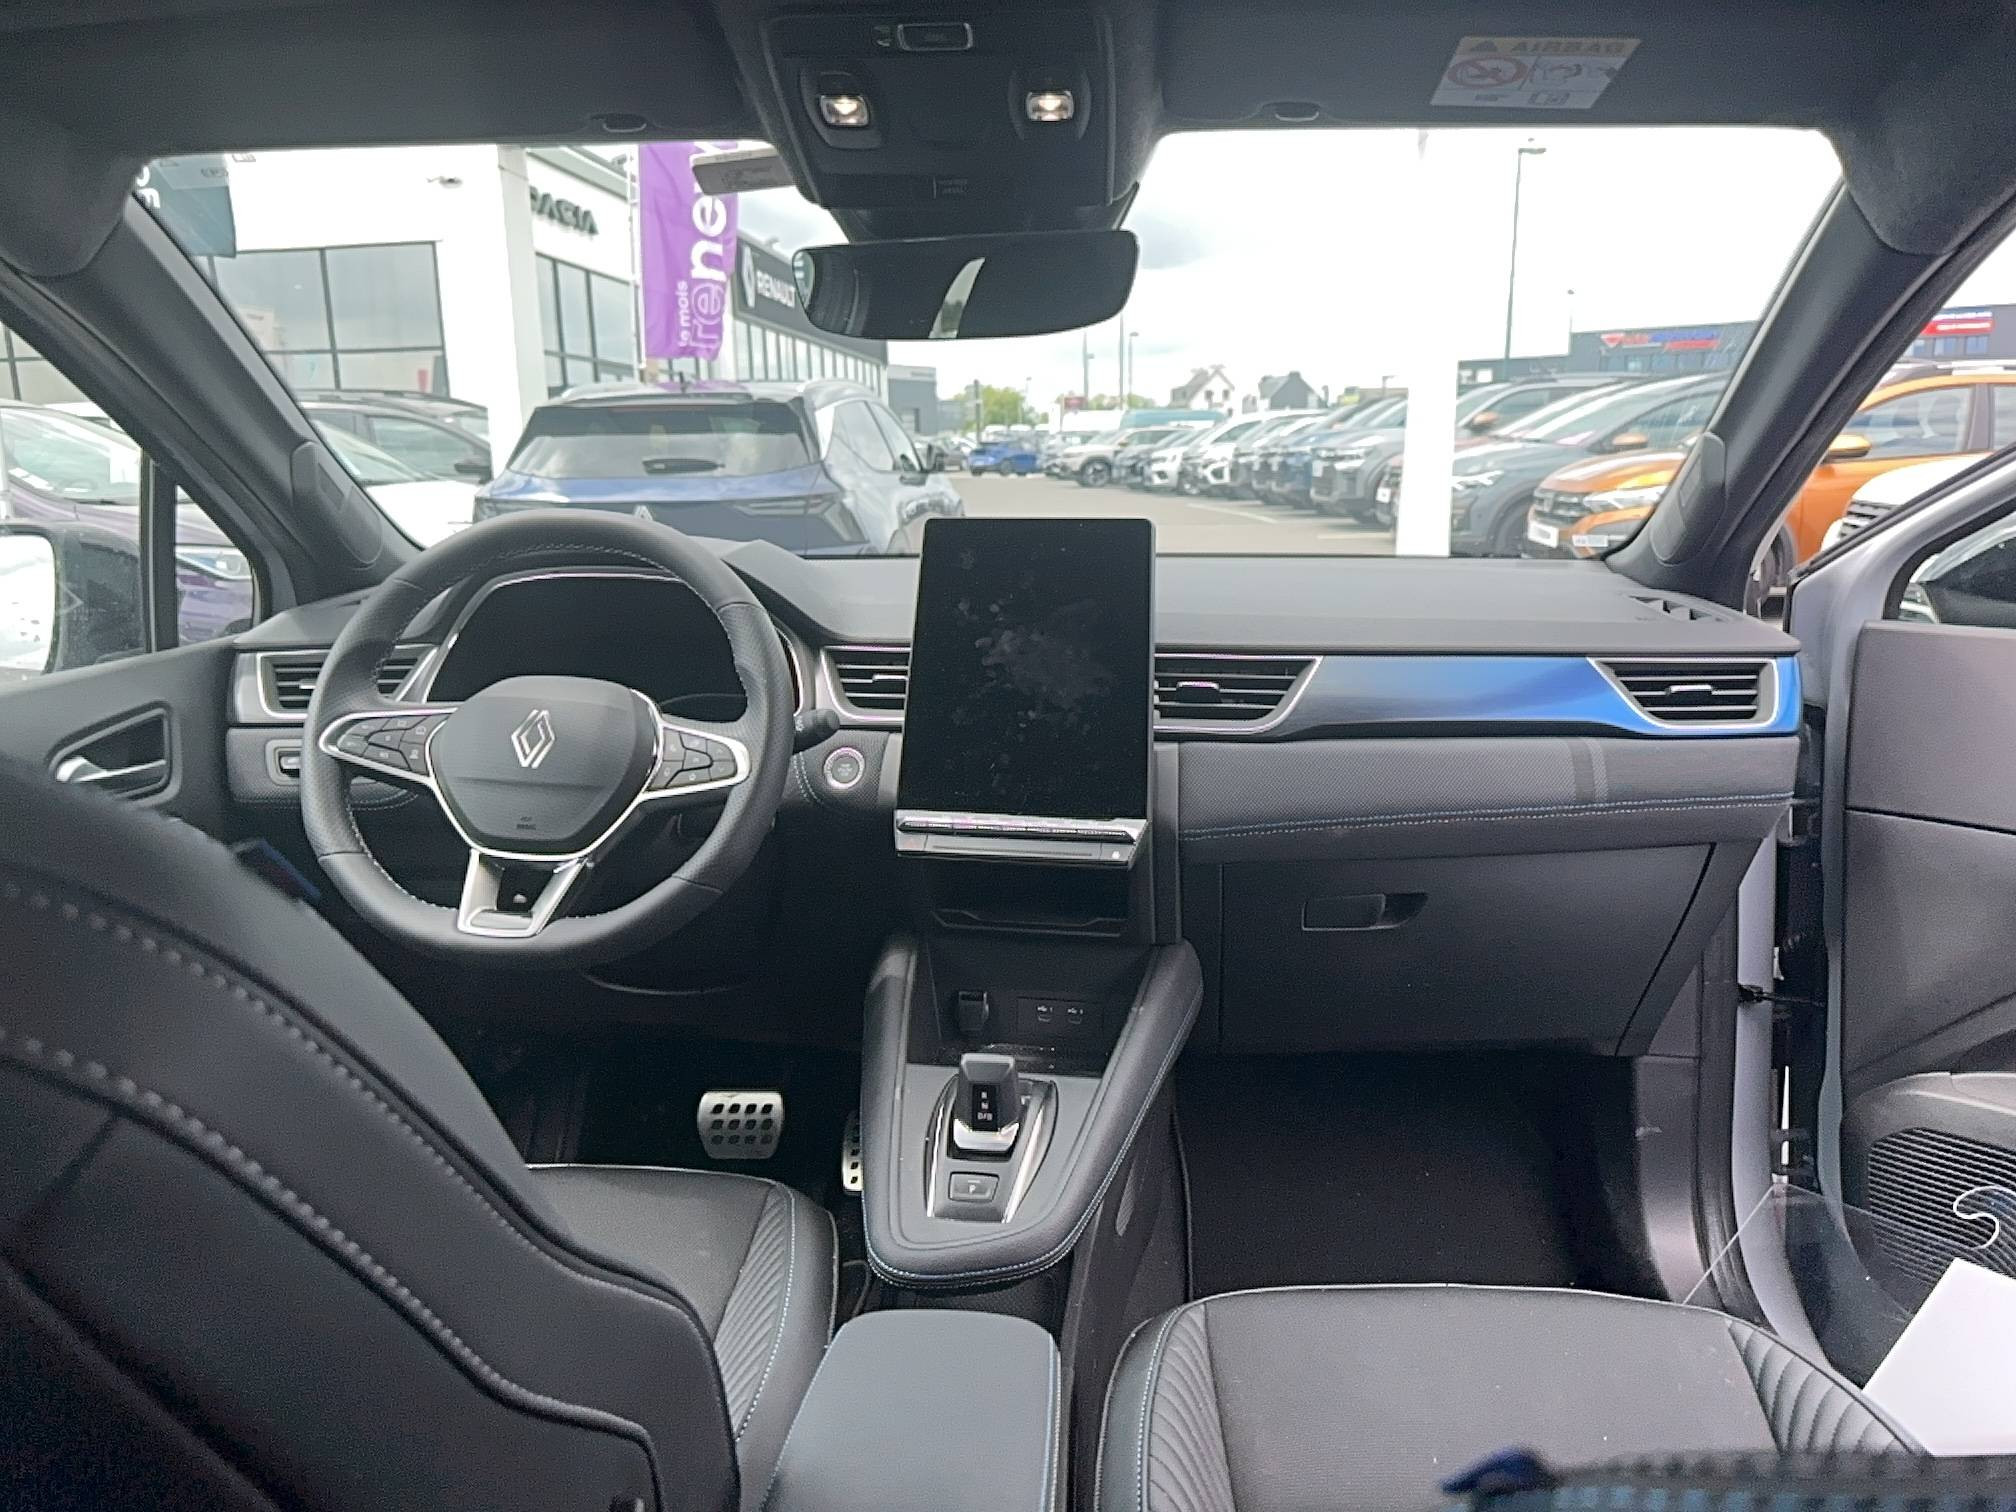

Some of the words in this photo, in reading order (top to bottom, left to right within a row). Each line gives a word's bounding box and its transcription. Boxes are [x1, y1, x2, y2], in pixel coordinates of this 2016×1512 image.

[1510, 41, 1626, 53] AIRBAG
[676, 280, 691, 327] mois
[756, 270, 796, 308] RENAULT
